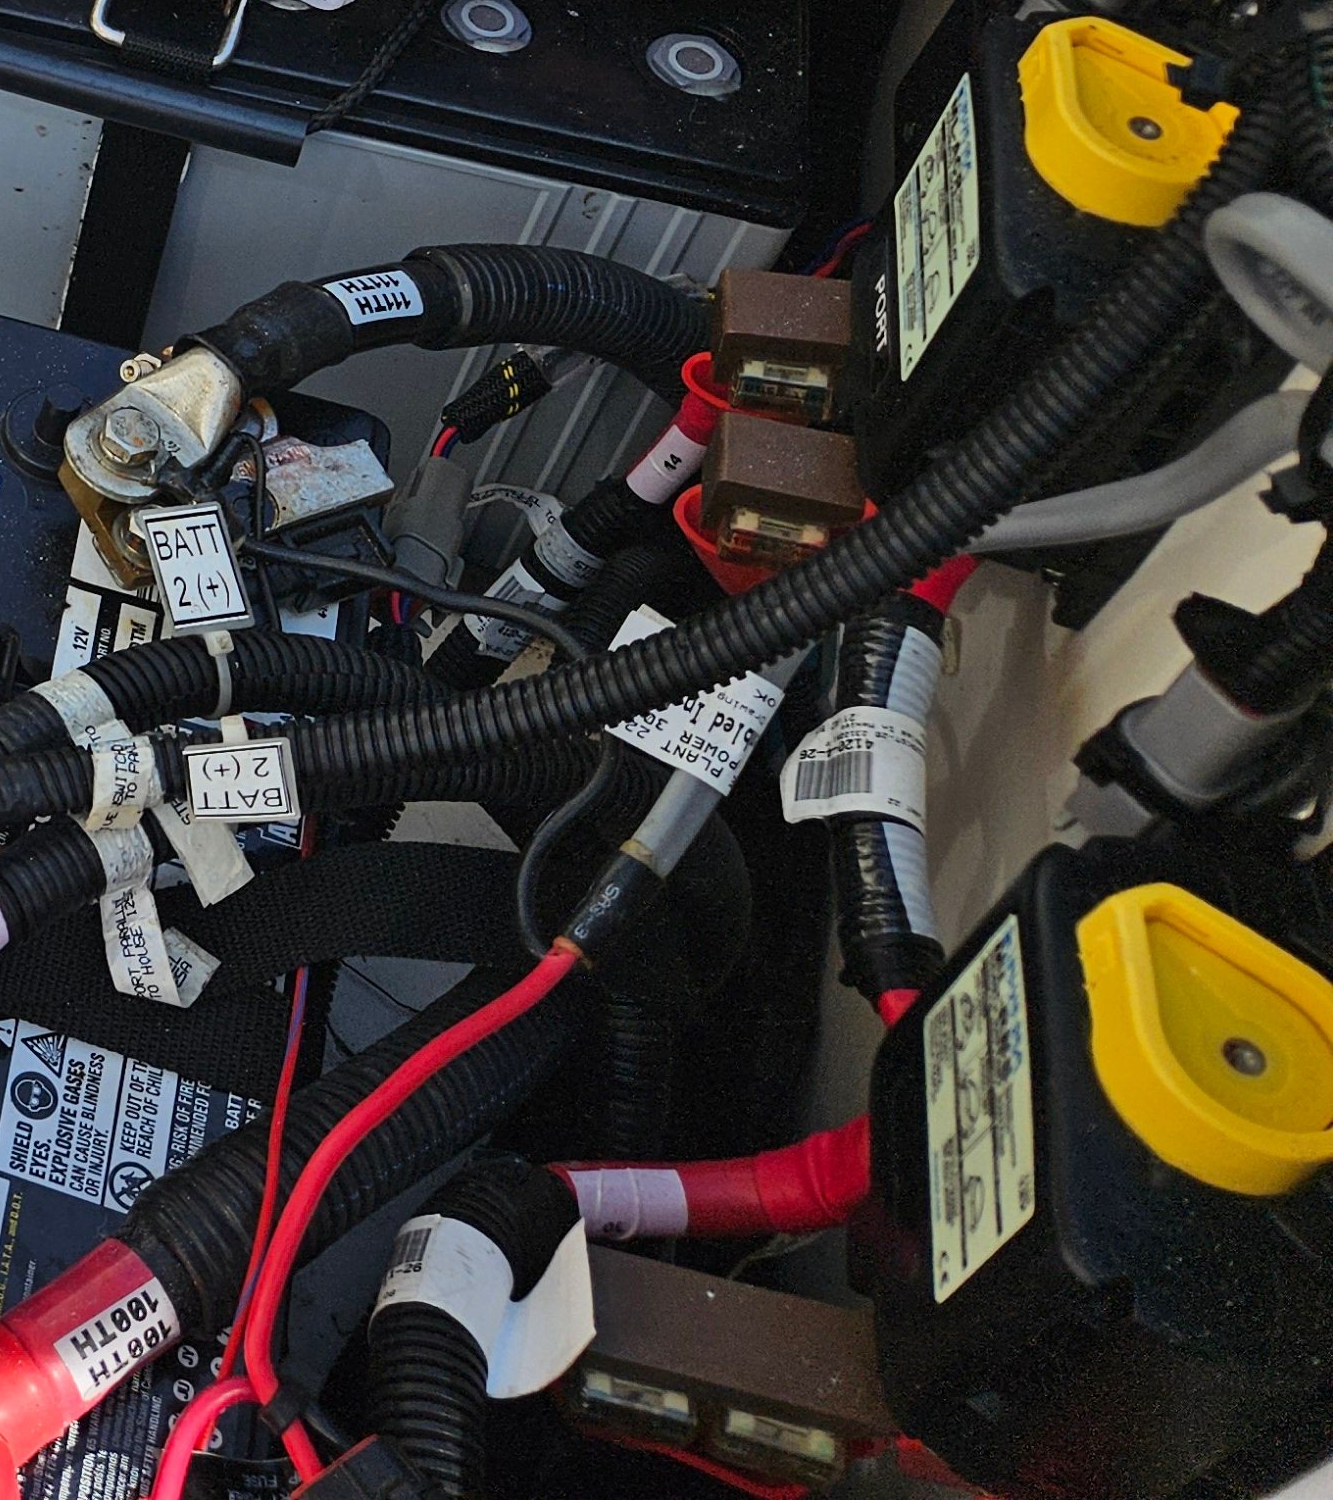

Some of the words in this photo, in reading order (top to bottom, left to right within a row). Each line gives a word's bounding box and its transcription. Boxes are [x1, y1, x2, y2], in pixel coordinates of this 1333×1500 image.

[338, 272, 399, 294] 111TH
[354, 290, 411, 316] 111TH
[862, 273, 898, 352] PORT
[660, 451, 683, 474] 14
[152, 522, 220, 562] BATT
[172, 574, 191, 607] 2
[195, 568, 232, 612] (+)
[70, 624, 90, 652] 12V
[659, 737, 724, 778] PLANT
[677, 728, 742, 769] POWER
[201, 754, 241, 783] (+)
[251, 756, 269, 778] 2
[195, 785, 282, 813] BATT
[61, 1057, 86, 1105] GASES
[78, 1051, 107, 1121] BLINDNESS
[129, 1074, 146, 1093] OF
[177, 1078, 196, 1105] FIRE
[124, 1094, 143, 1120] OUT
[142, 1095, 159, 1116] OF
[175, 1104, 192, 1122] OF
[7, 1119, 34, 1173] SHIELD
[47, 1104, 79, 1186] EXPLOSIVE
[71, 1120, 94, 1164] CAUSE
[86, 1126, 110, 1176] INJURY.
[118, 1120, 139, 1153] KEEP
[134, 1115, 157, 1159] REACH
[168, 1124, 188, 1153] RISK
[27, 1135, 52, 1179] EYES.
[66, 1163, 86, 1192] CAN
[83, 1176, 101, 1197] OR
[69, 1287, 162, 1360] 100TH
[85, 1316, 176, 1387] 100TH
